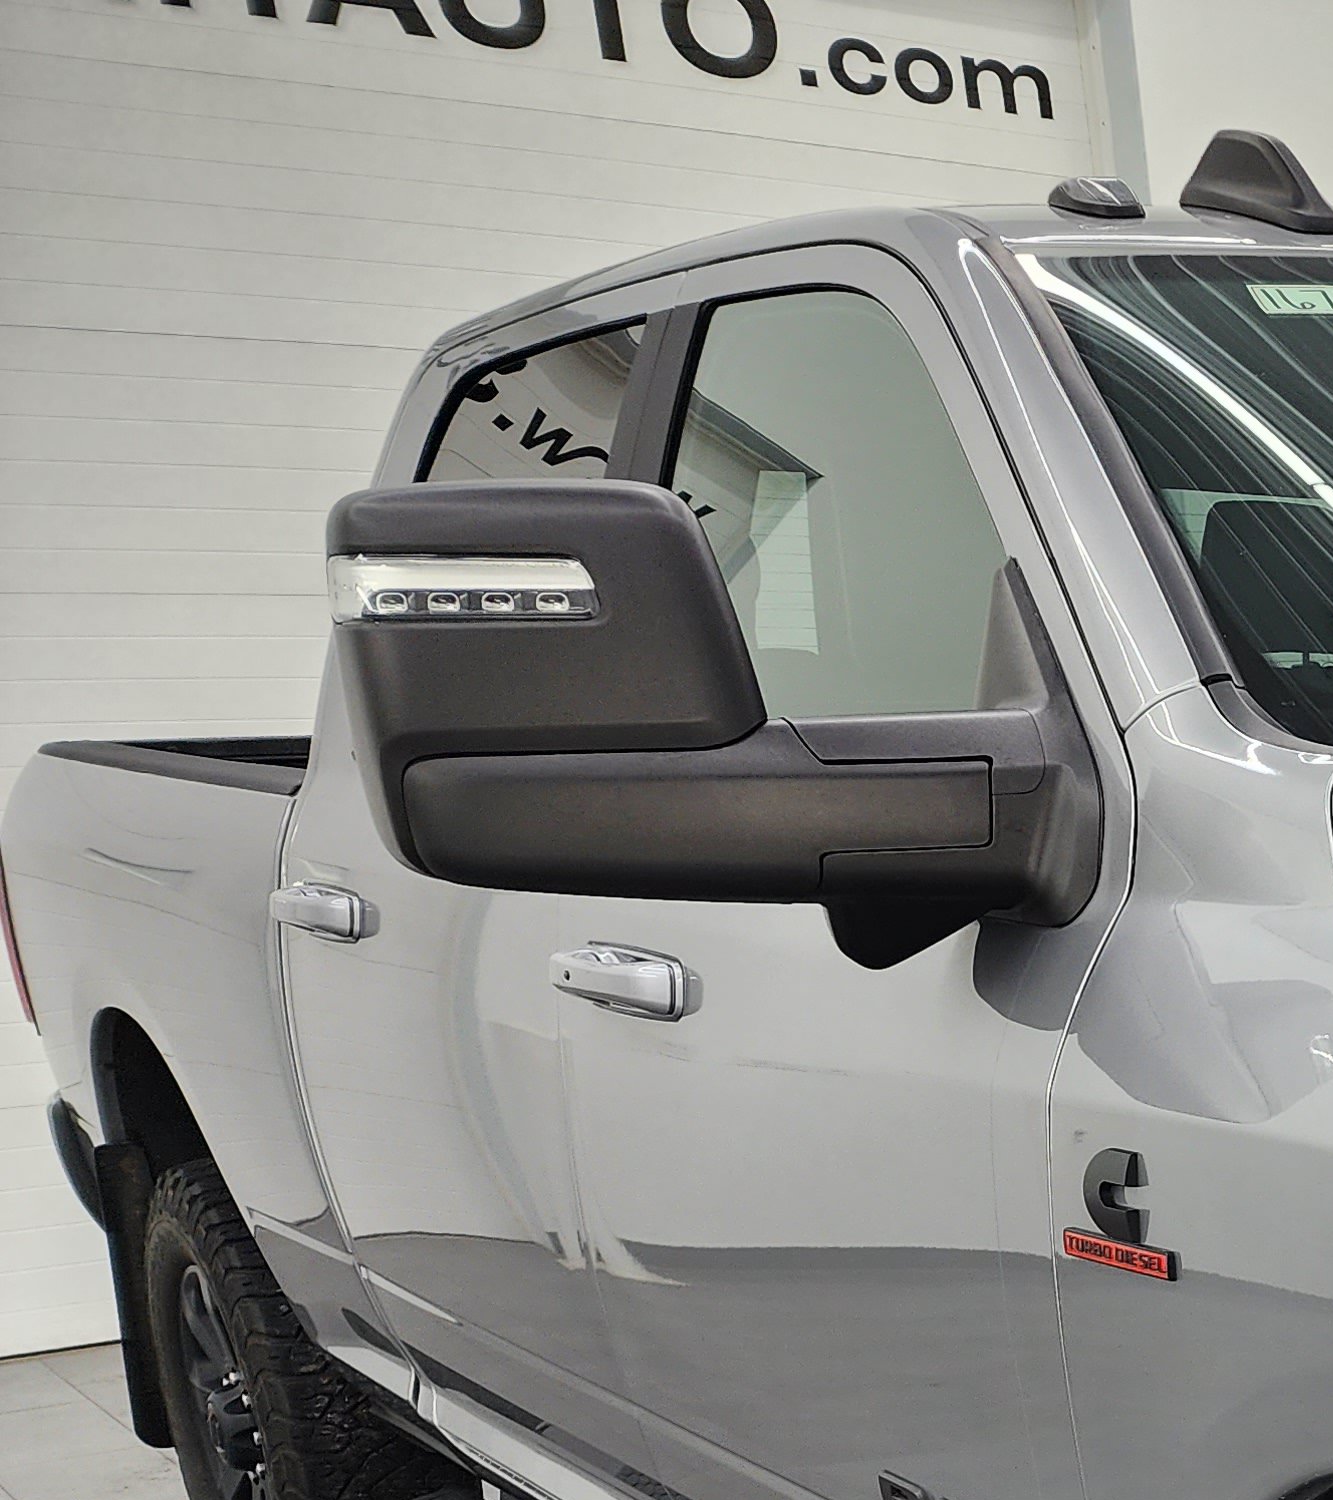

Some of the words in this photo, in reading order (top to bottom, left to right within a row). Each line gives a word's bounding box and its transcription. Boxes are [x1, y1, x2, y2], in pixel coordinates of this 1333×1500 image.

[160, 0, 1054, 120] O.com
[1066, 1234, 1112, 1261] TURBO
[1114, 1246, 1168, 1274] DIESEL
